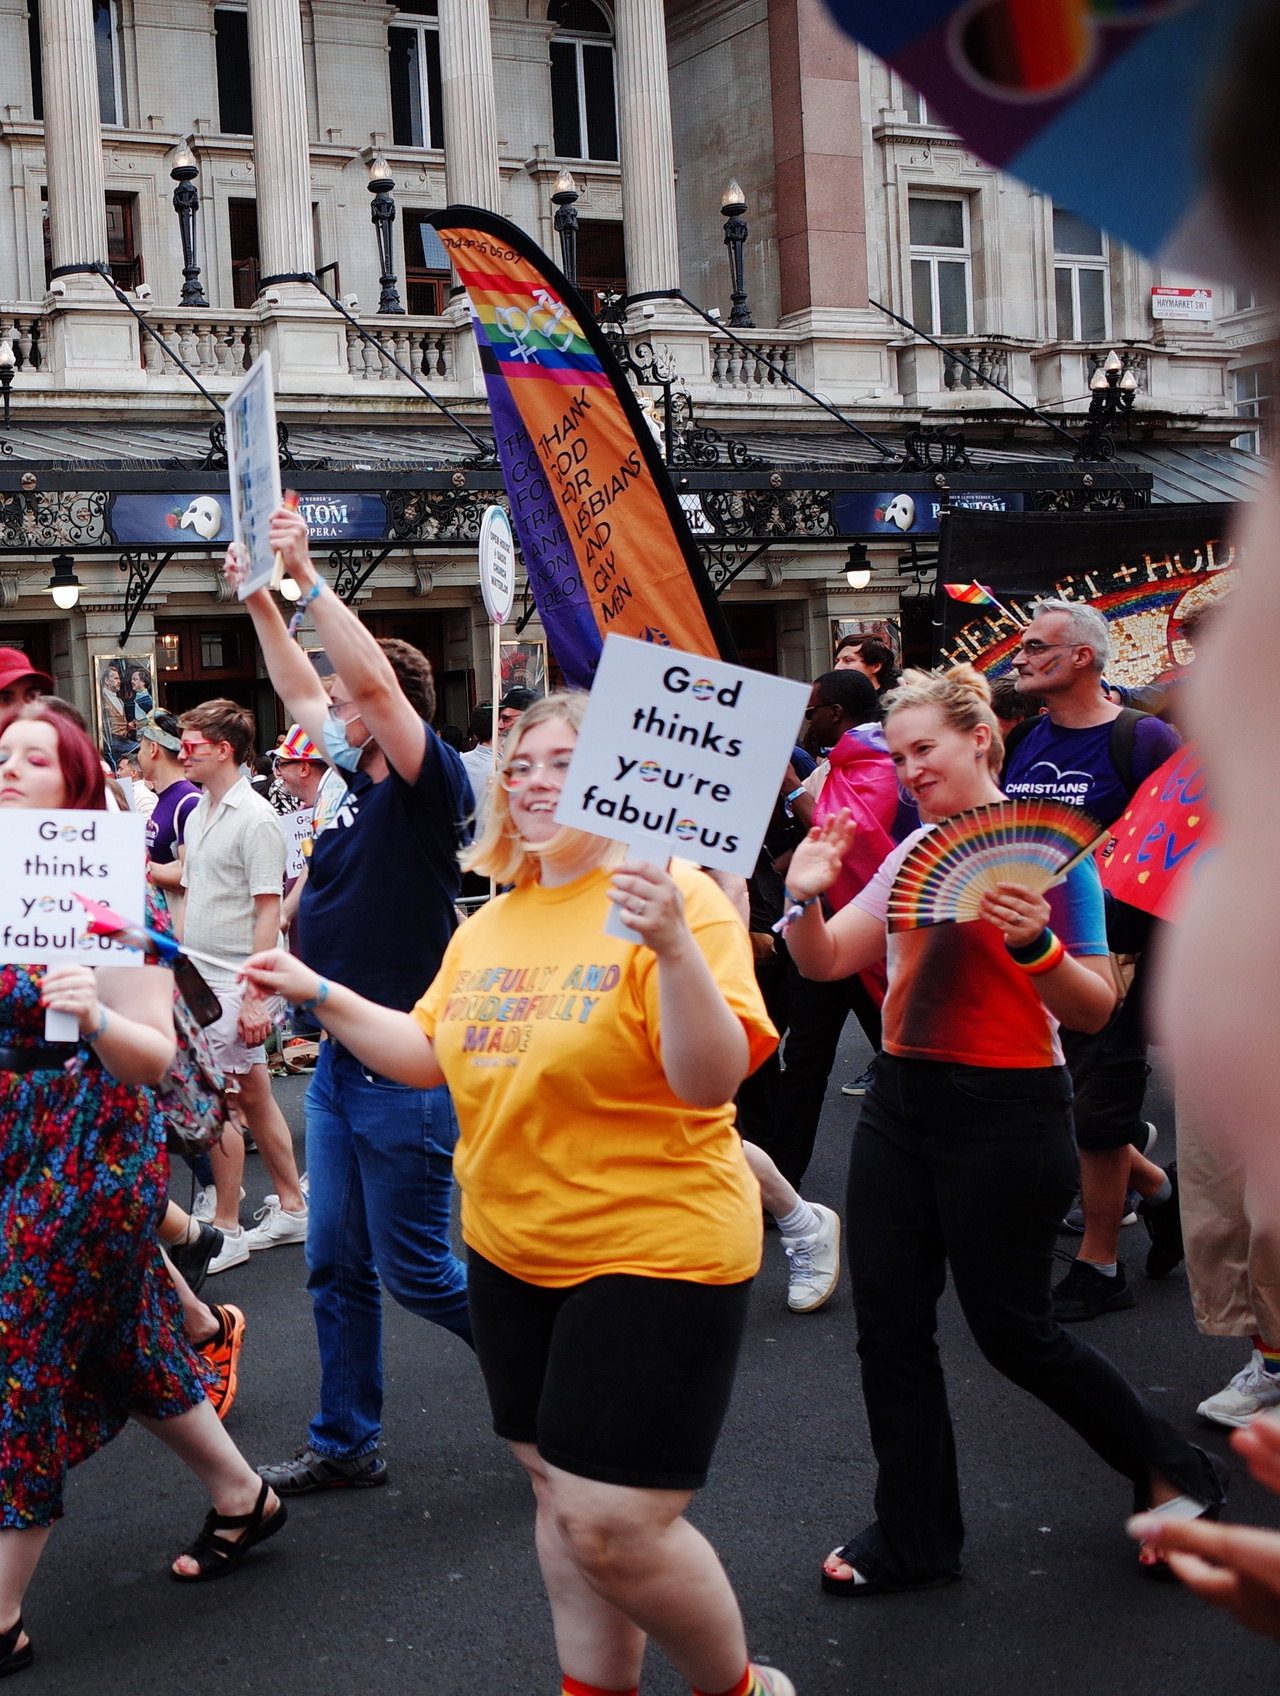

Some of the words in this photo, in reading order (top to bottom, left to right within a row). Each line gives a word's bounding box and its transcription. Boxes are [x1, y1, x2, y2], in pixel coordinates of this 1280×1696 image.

[1157, 299, 1194, 309] HAYMARKET
[538, 387, 592, 459] THANK
[511, 449, 540, 484] GO
[550, 437, 588, 484] GOD
[561, 468, 592, 507] FOR
[573, 450, 641, 538] LESBIANS
[521, 504, 558, 534] TRA
[586, 522, 611, 567] AND
[593, 551, 617, 594] GAY
[601, 577, 633, 624] MEN
[663, 666, 744, 708] God
[632, 706, 744, 757] thinks
[613, 755, 732, 803] you're
[1005, 783, 1088, 794] CHRISTIANS
[39, 821, 96, 842] God
[296, 816, 312, 825] Go
[581, 785, 740, 854] fabulous
[24, 855, 109, 878] thinks
[452, 967, 558, 994] EARFULLY
[561, 964, 620, 991] AND
[462, 1025, 534, 1053] MADE
